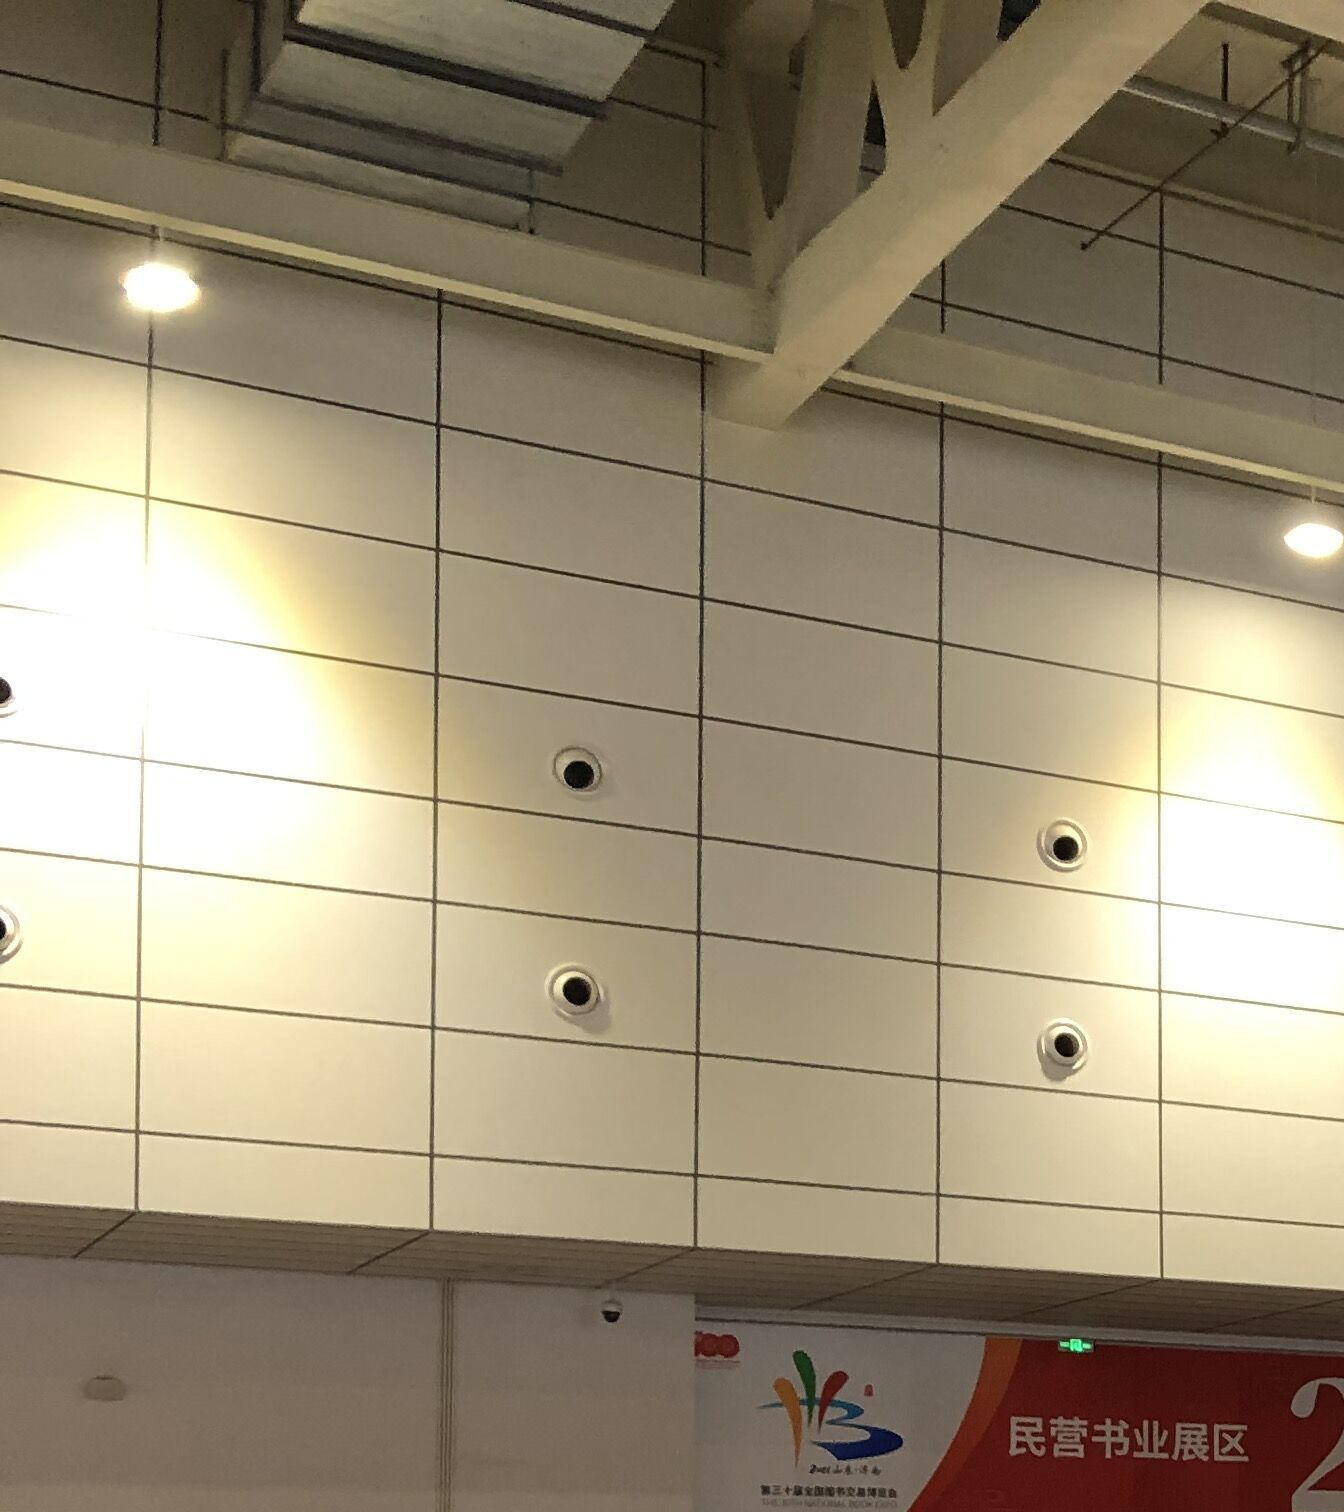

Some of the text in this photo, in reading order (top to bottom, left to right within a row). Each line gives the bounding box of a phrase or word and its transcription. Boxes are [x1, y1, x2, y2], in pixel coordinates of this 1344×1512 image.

[1008, 1415, 1251, 1463] 民营书业展区
